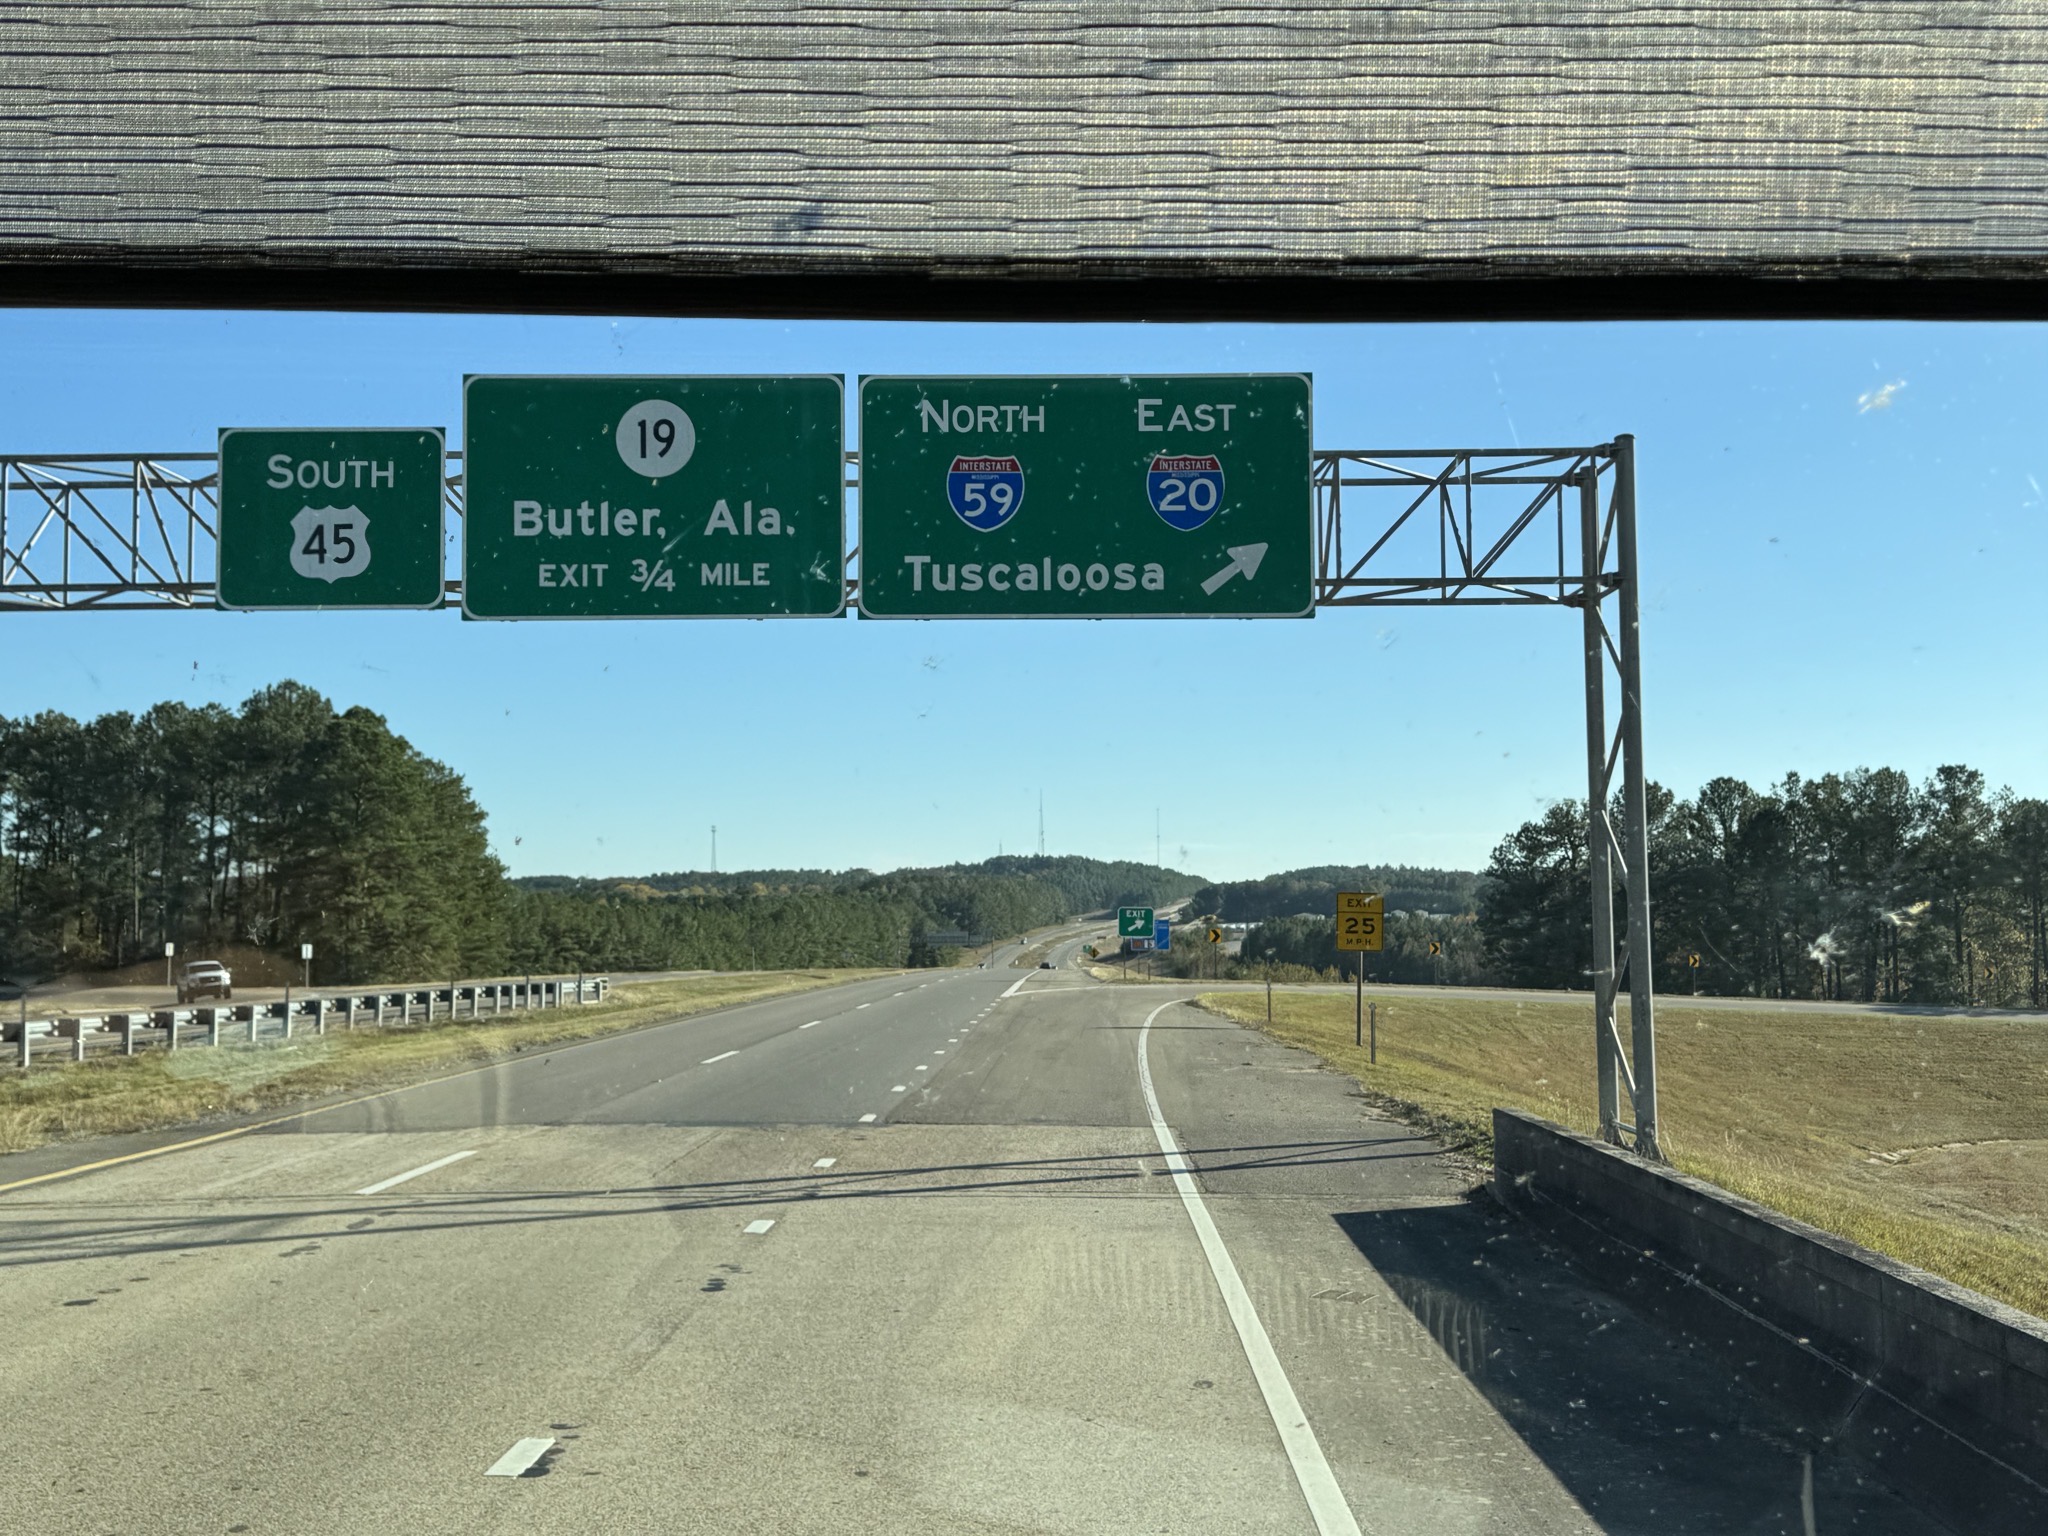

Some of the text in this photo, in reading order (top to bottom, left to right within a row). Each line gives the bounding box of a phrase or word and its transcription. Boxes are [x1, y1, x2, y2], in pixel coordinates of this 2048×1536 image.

[921, 399, 1045, 433] NORTH
[1137, 398, 1237, 432] EAST
[636, 418, 676, 459] 19
[266, 454, 395, 490] SOUTH
[959, 461, 1013, 471] INTERSTATE
[1159, 460, 1213, 470] INTERSTATE
[963, 482, 1014, 518] 59
[1158, 478, 1218, 512] 20
[513, 500, 797, 540] Butler, Ala.
[301, 523, 356, 565] 45
[538, 563, 609, 588] EXIT
[700, 562, 771, 587] MILE
[904, 555, 1166, 592] Tuscaloosa
[1126, 910, 1146, 918] EXIT
[1345, 917, 1375, 934] 25
